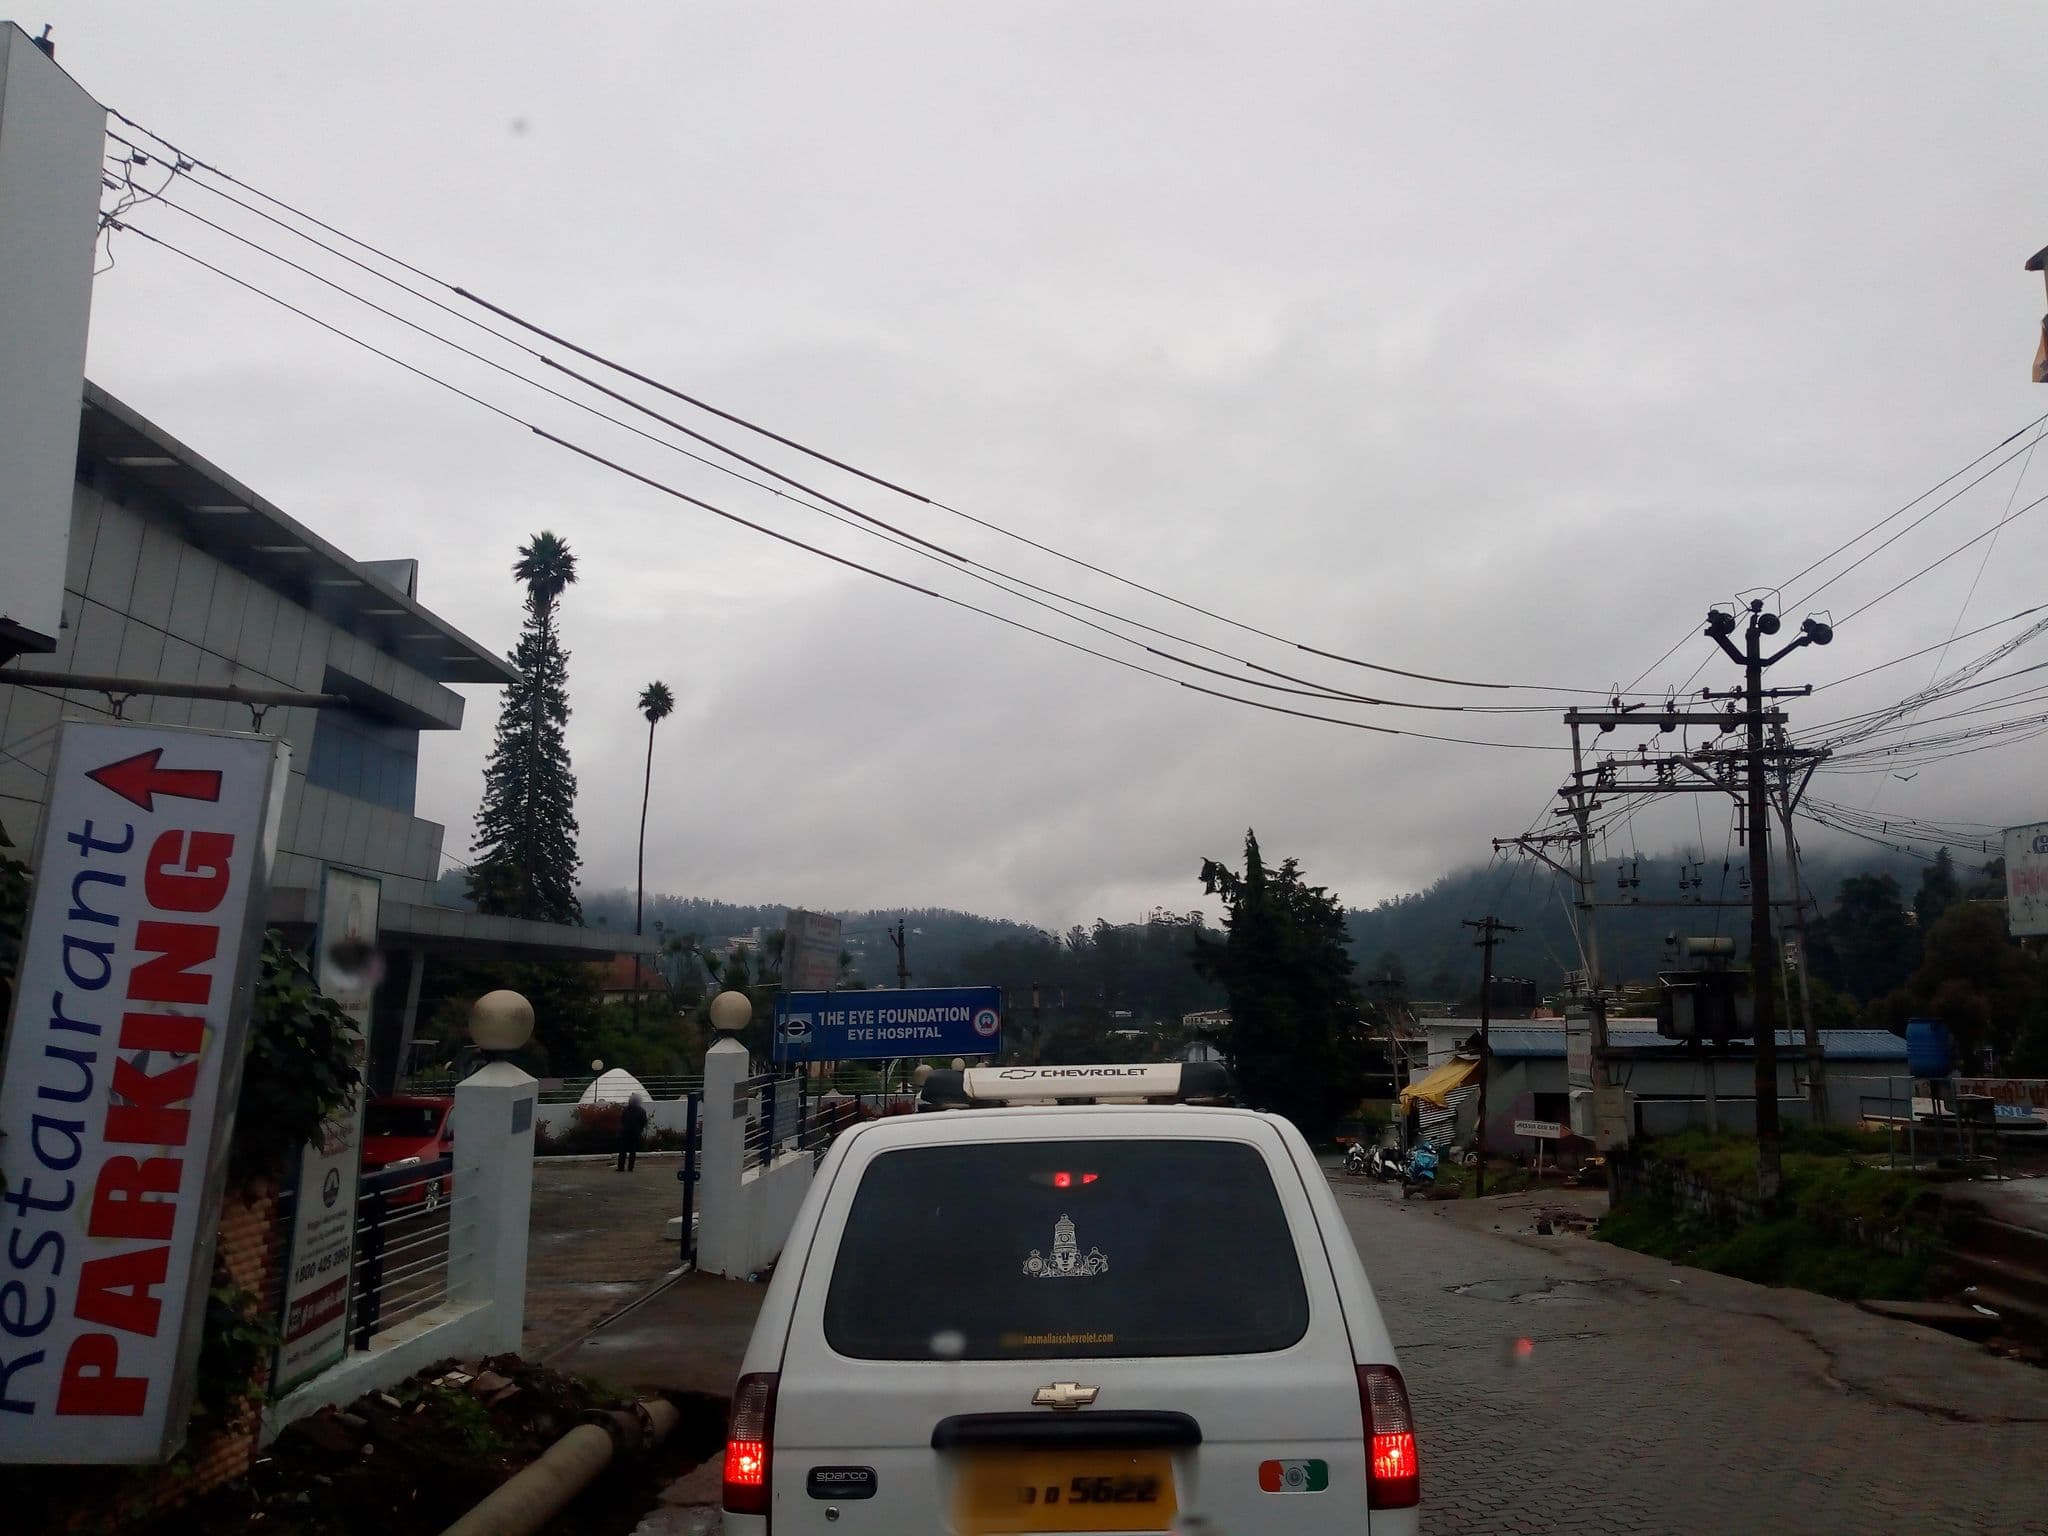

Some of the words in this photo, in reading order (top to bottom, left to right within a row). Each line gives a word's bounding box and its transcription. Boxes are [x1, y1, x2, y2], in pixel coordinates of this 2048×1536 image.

[818, 1010, 845, 1026] THE
[848, 1009, 874, 1025] EYE
[878, 1006, 970, 1024] FOUNDATION
[847, 1028, 874, 1041] EYE
[877, 1026, 942, 1040] HOSPITAL
[1041, 1068, 1147, 1078] CHEVROLET
[0, 820, 135, 1415] Restaurant
[56, 829, 236, 1418] PARKING
[816, 1471, 869, 1483] sparco
